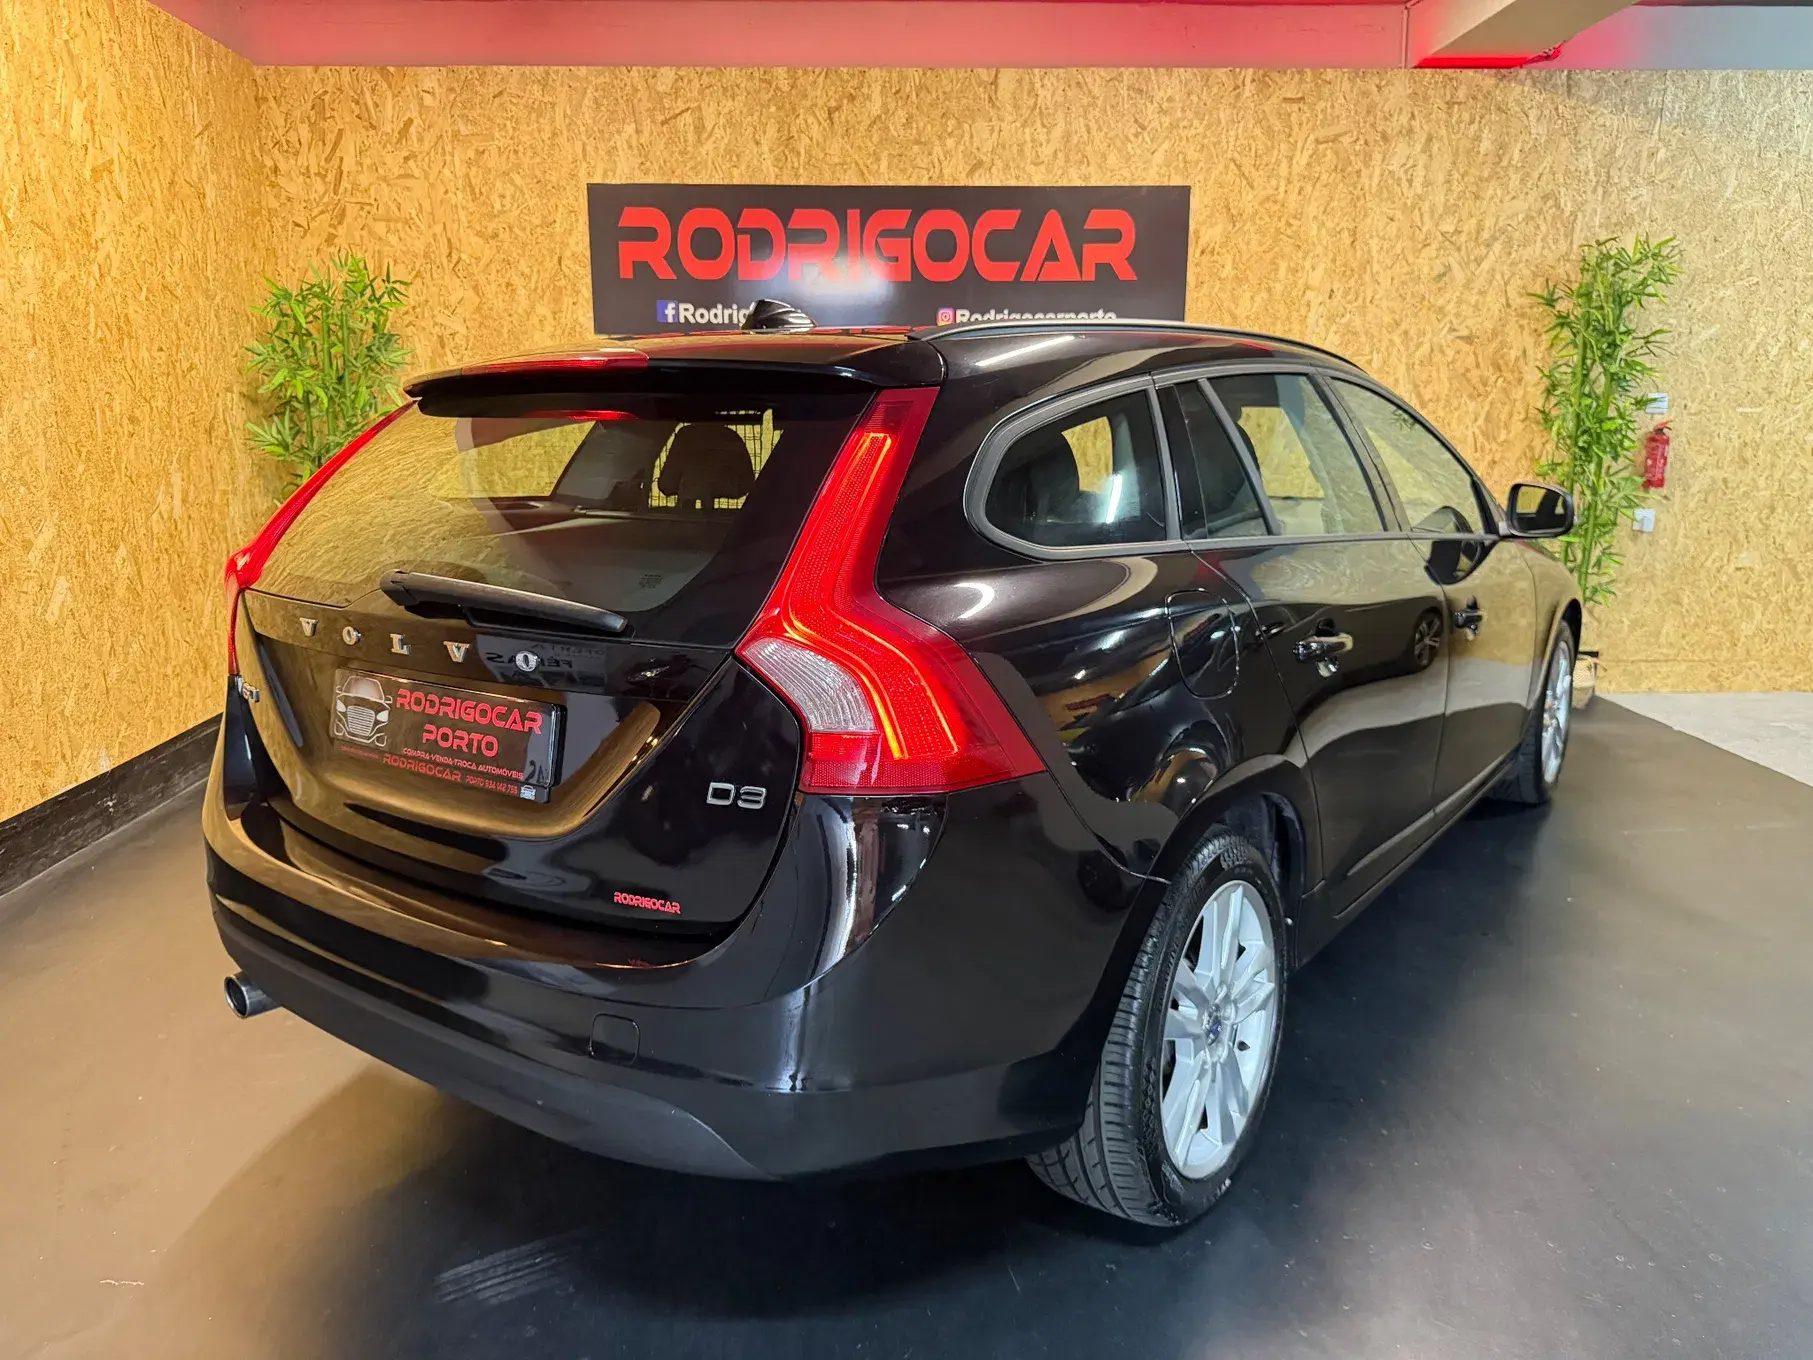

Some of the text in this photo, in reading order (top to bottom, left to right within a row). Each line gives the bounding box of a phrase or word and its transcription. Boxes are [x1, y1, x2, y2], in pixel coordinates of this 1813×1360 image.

[618, 206, 1138, 282] RODRIGOCAR
[299, 617, 541, 672] VOLVO
[396, 688, 543, 735] RODRIGOCAR
[422, 724, 499, 757] PORTO
[382, 753, 461, 783] RODRIGOCAR
[465, 775, 484, 787] PORTO
[478, 764, 524, 780] AUTOMÓVEIS
[706, 782, 767, 809] D3
[614, 891, 681, 914] RODRIGOCAR
